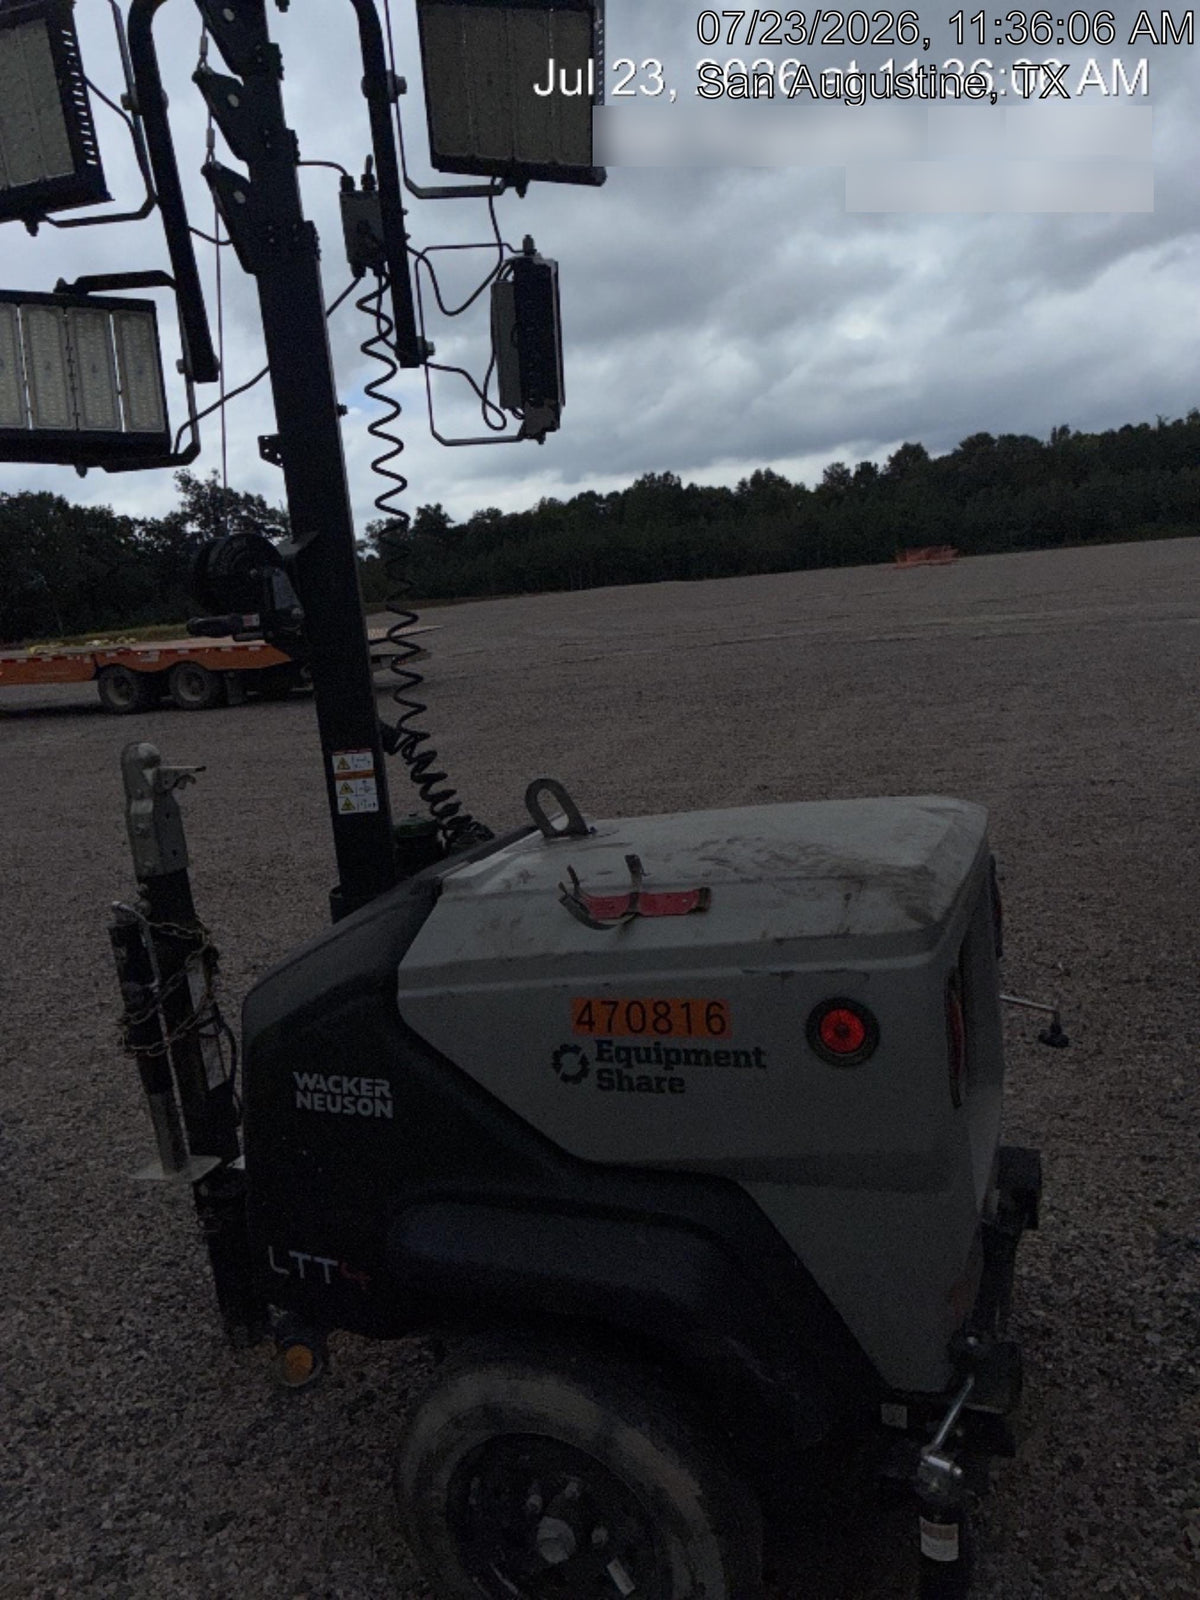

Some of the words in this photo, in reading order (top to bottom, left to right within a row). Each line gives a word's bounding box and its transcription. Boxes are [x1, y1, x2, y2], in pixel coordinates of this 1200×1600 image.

[576, 1000, 727, 1035] 470816
[595, 1040, 767, 1071] Equipment
[293, 1071, 392, 1098] WACKER
[596, 1069, 686, 1093] Share
[294, 1091, 394, 1119] NEUSON
